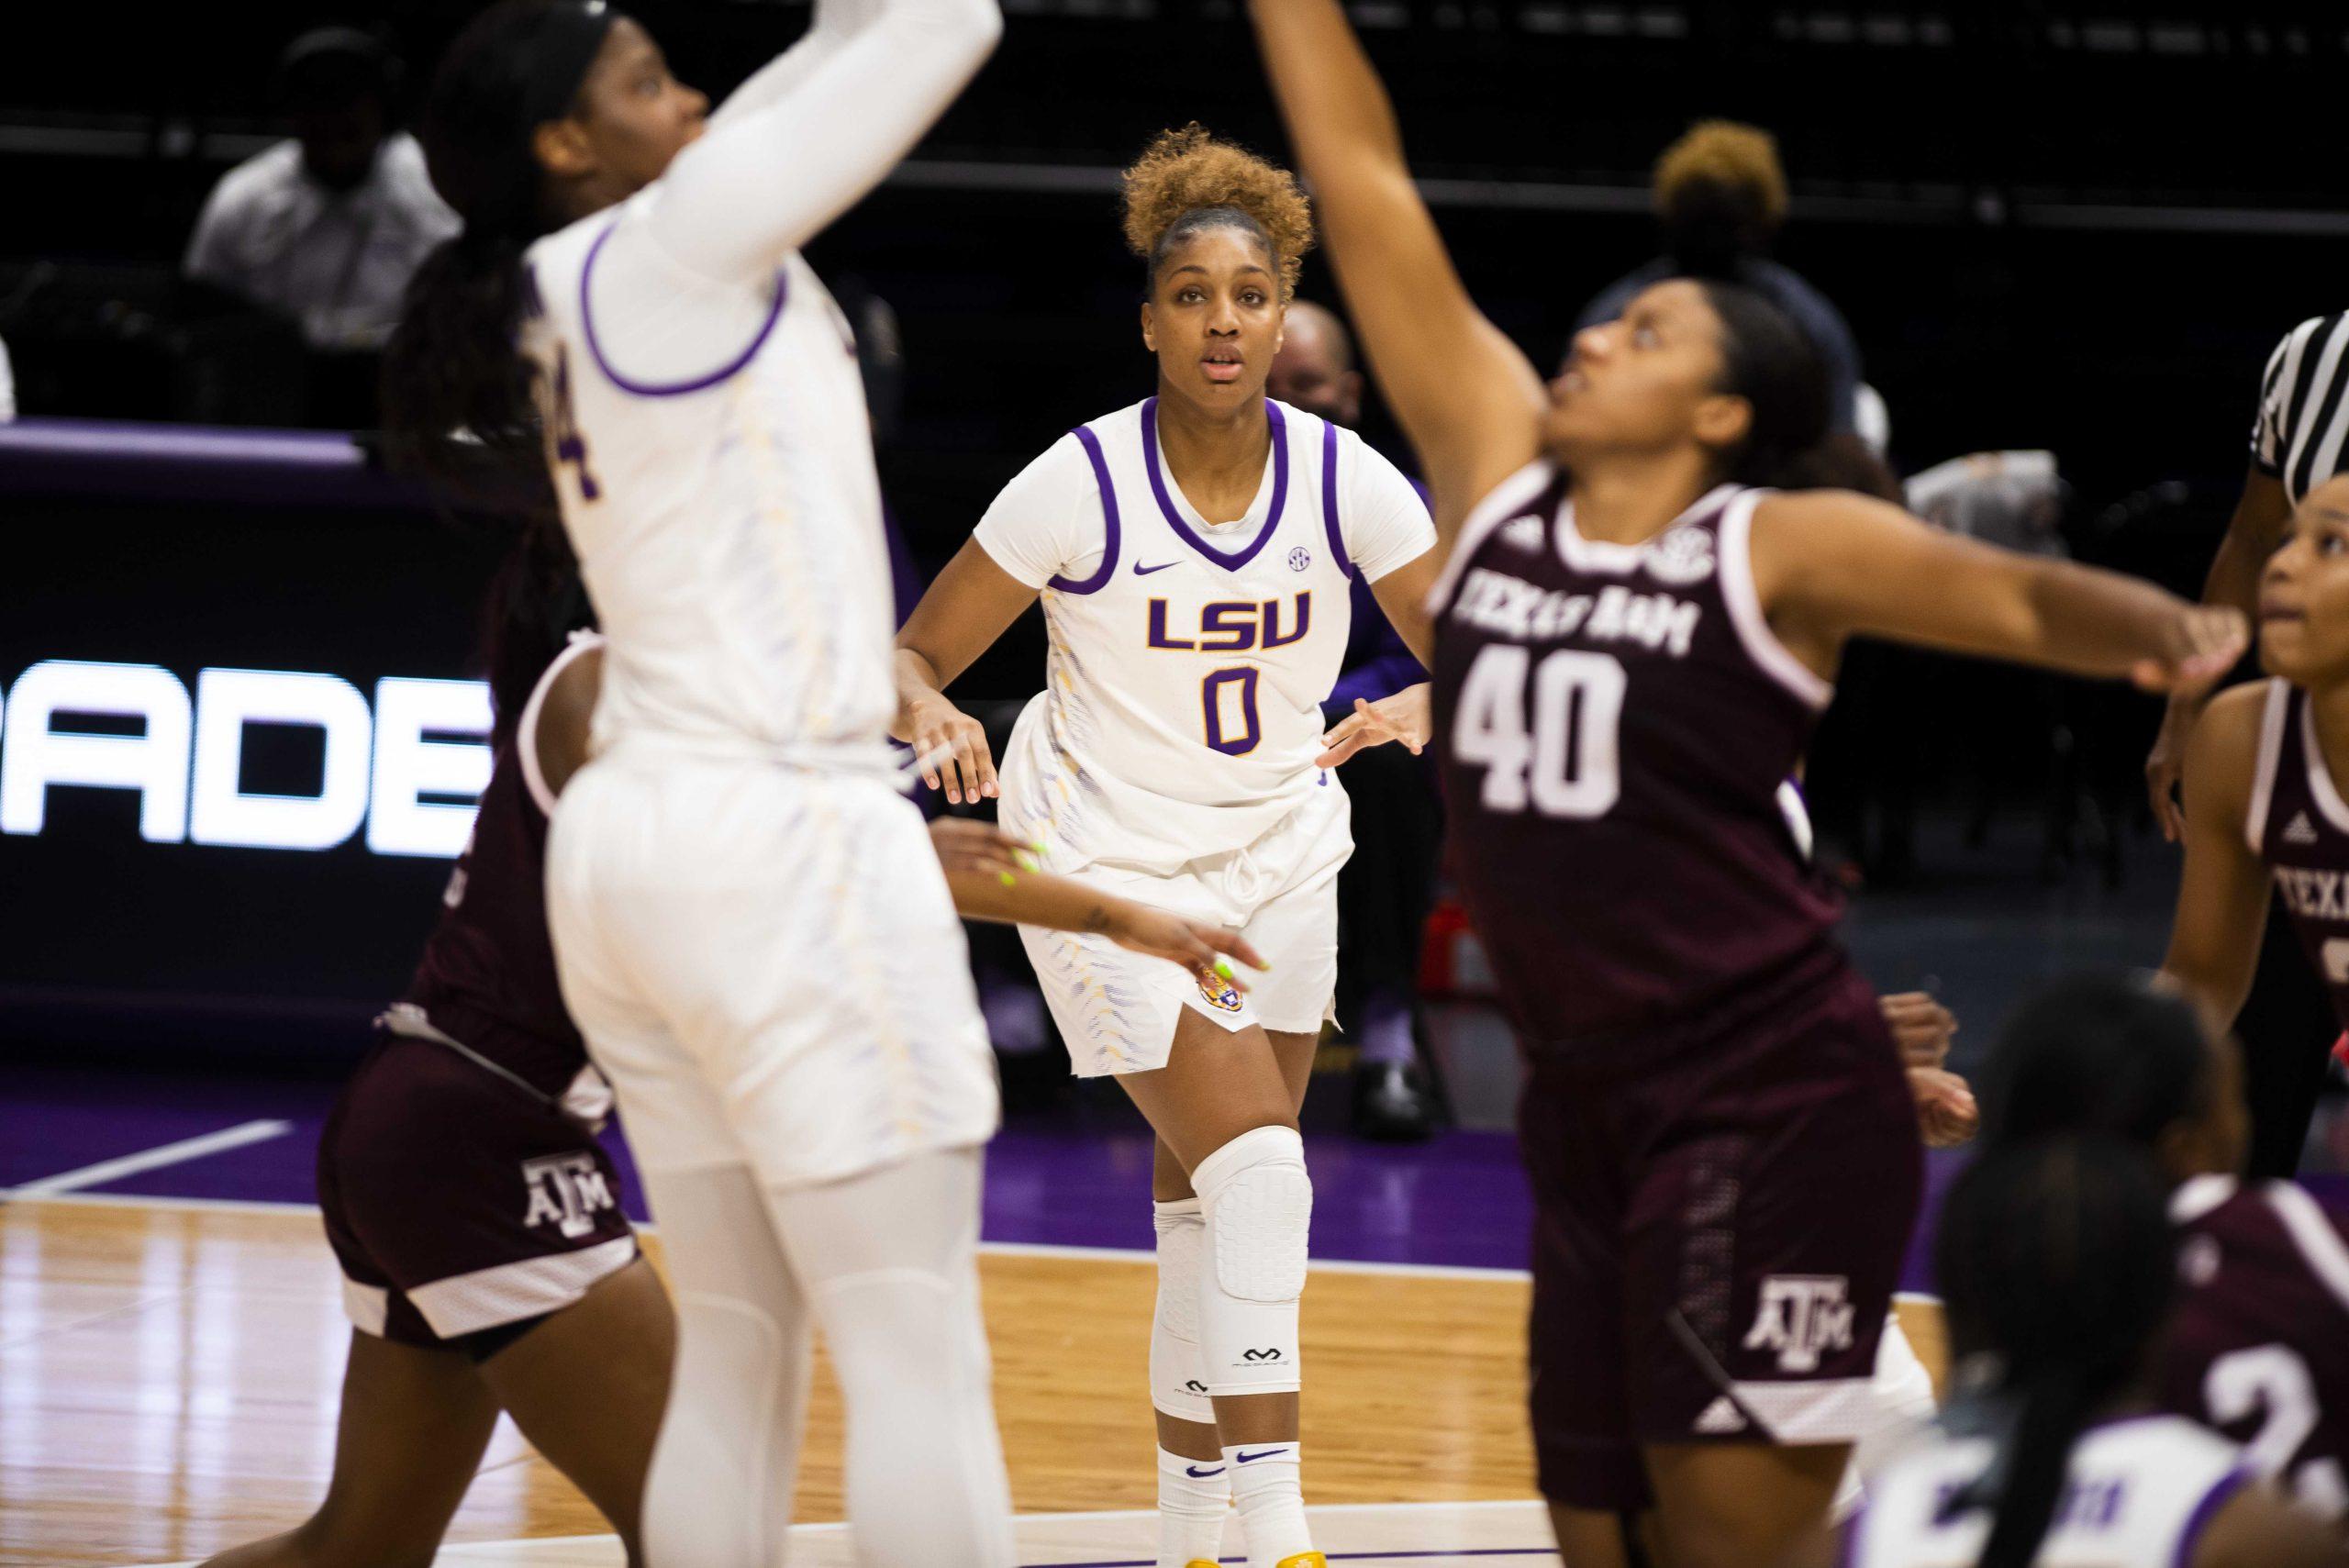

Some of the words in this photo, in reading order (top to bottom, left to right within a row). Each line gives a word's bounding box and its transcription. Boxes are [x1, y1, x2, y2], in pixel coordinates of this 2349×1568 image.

[1145, 589, 1313, 653] LSU
[0, 658, 495, 858] ADE
[1203, 666, 1262, 759] 0
[1453, 641, 1629, 820] 40
